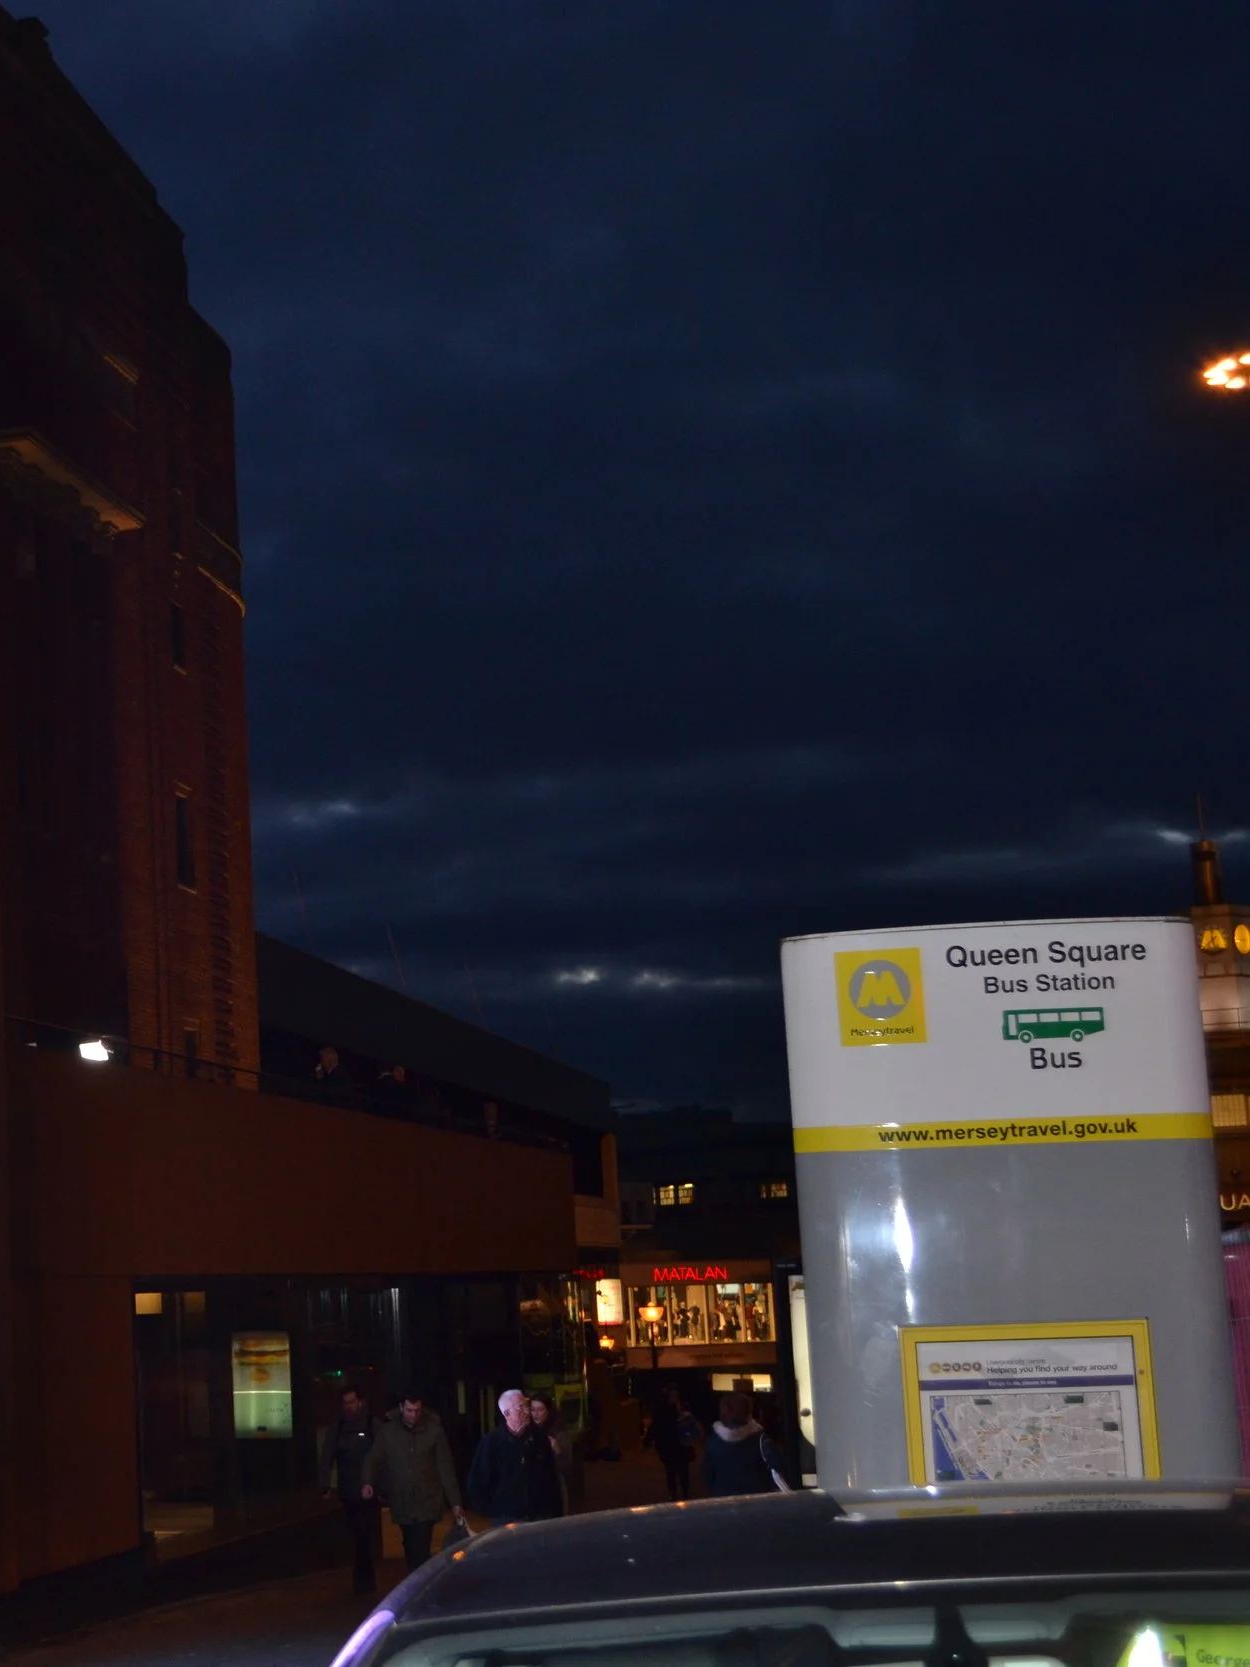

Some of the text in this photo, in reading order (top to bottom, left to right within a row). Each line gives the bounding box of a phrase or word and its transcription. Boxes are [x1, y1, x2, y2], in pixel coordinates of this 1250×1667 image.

[945, 940, 1147, 968] Queen Square
[983, 972, 1116, 994] Bus Station
[1029, 1047, 1083, 1070] Bus
[878, 1117, 1138, 1143] www.merseytravel.gov.uk
[653, 1266, 728, 1282] MATALAN
[1053, 1365, 1070, 1373] your
[1090, 1363, 1117, 1371] around
